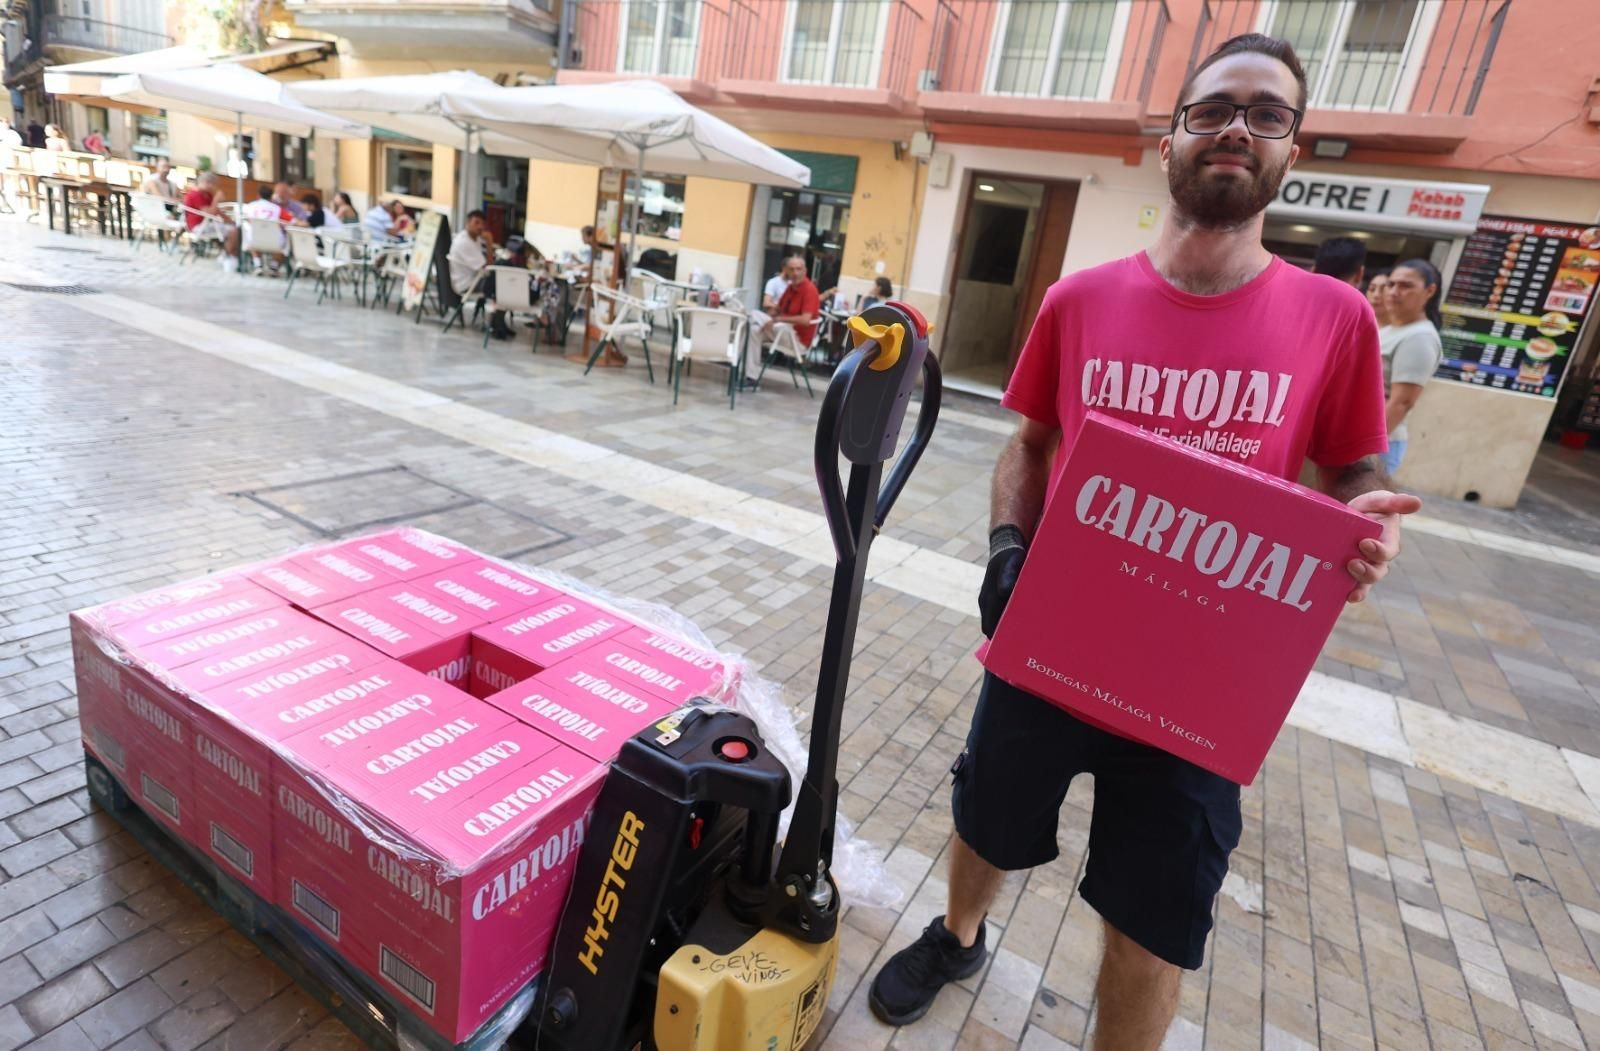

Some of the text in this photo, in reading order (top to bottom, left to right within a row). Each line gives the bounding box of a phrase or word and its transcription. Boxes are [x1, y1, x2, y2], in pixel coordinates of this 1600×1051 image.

[1276, 179, 1372, 212] OFRE
[1411, 187, 1466, 207] Kebab
[1081, 358, 1293, 428] CARTOJAL
[1119, 561, 1226, 613] MÁLAGA
[502, 603, 577, 636] CARTOJAL
[543, 618, 617, 653] CARTOJAL
[203, 634, 317, 678] CARTOJAL
[237, 653, 351, 699] CARTOJAL
[476, 660, 520, 690] CARTO
[605, 652, 686, 692] CARTOJAL
[278, 673, 393, 724] CARTOJAL
[522, 693, 609, 742] CARTOJAL
[567, 671, 649, 714] CARTOJAL
[1026, 657, 1217, 750] BODEGAS MÁLAGA VIRGEN
[320, 693, 433, 748] CARTOJAL
[366, 715, 480, 776] CARTOJAL
[196, 733, 262, 797] CARTOJAL
[409, 739, 521, 804] CARTOJAL
[278, 785, 353, 855] CARTOJAL
[463, 765, 575, 837] CARTOJAL
[367, 845, 455, 924] CARTOJAL
[577, 810, 647, 976] HYSTER
